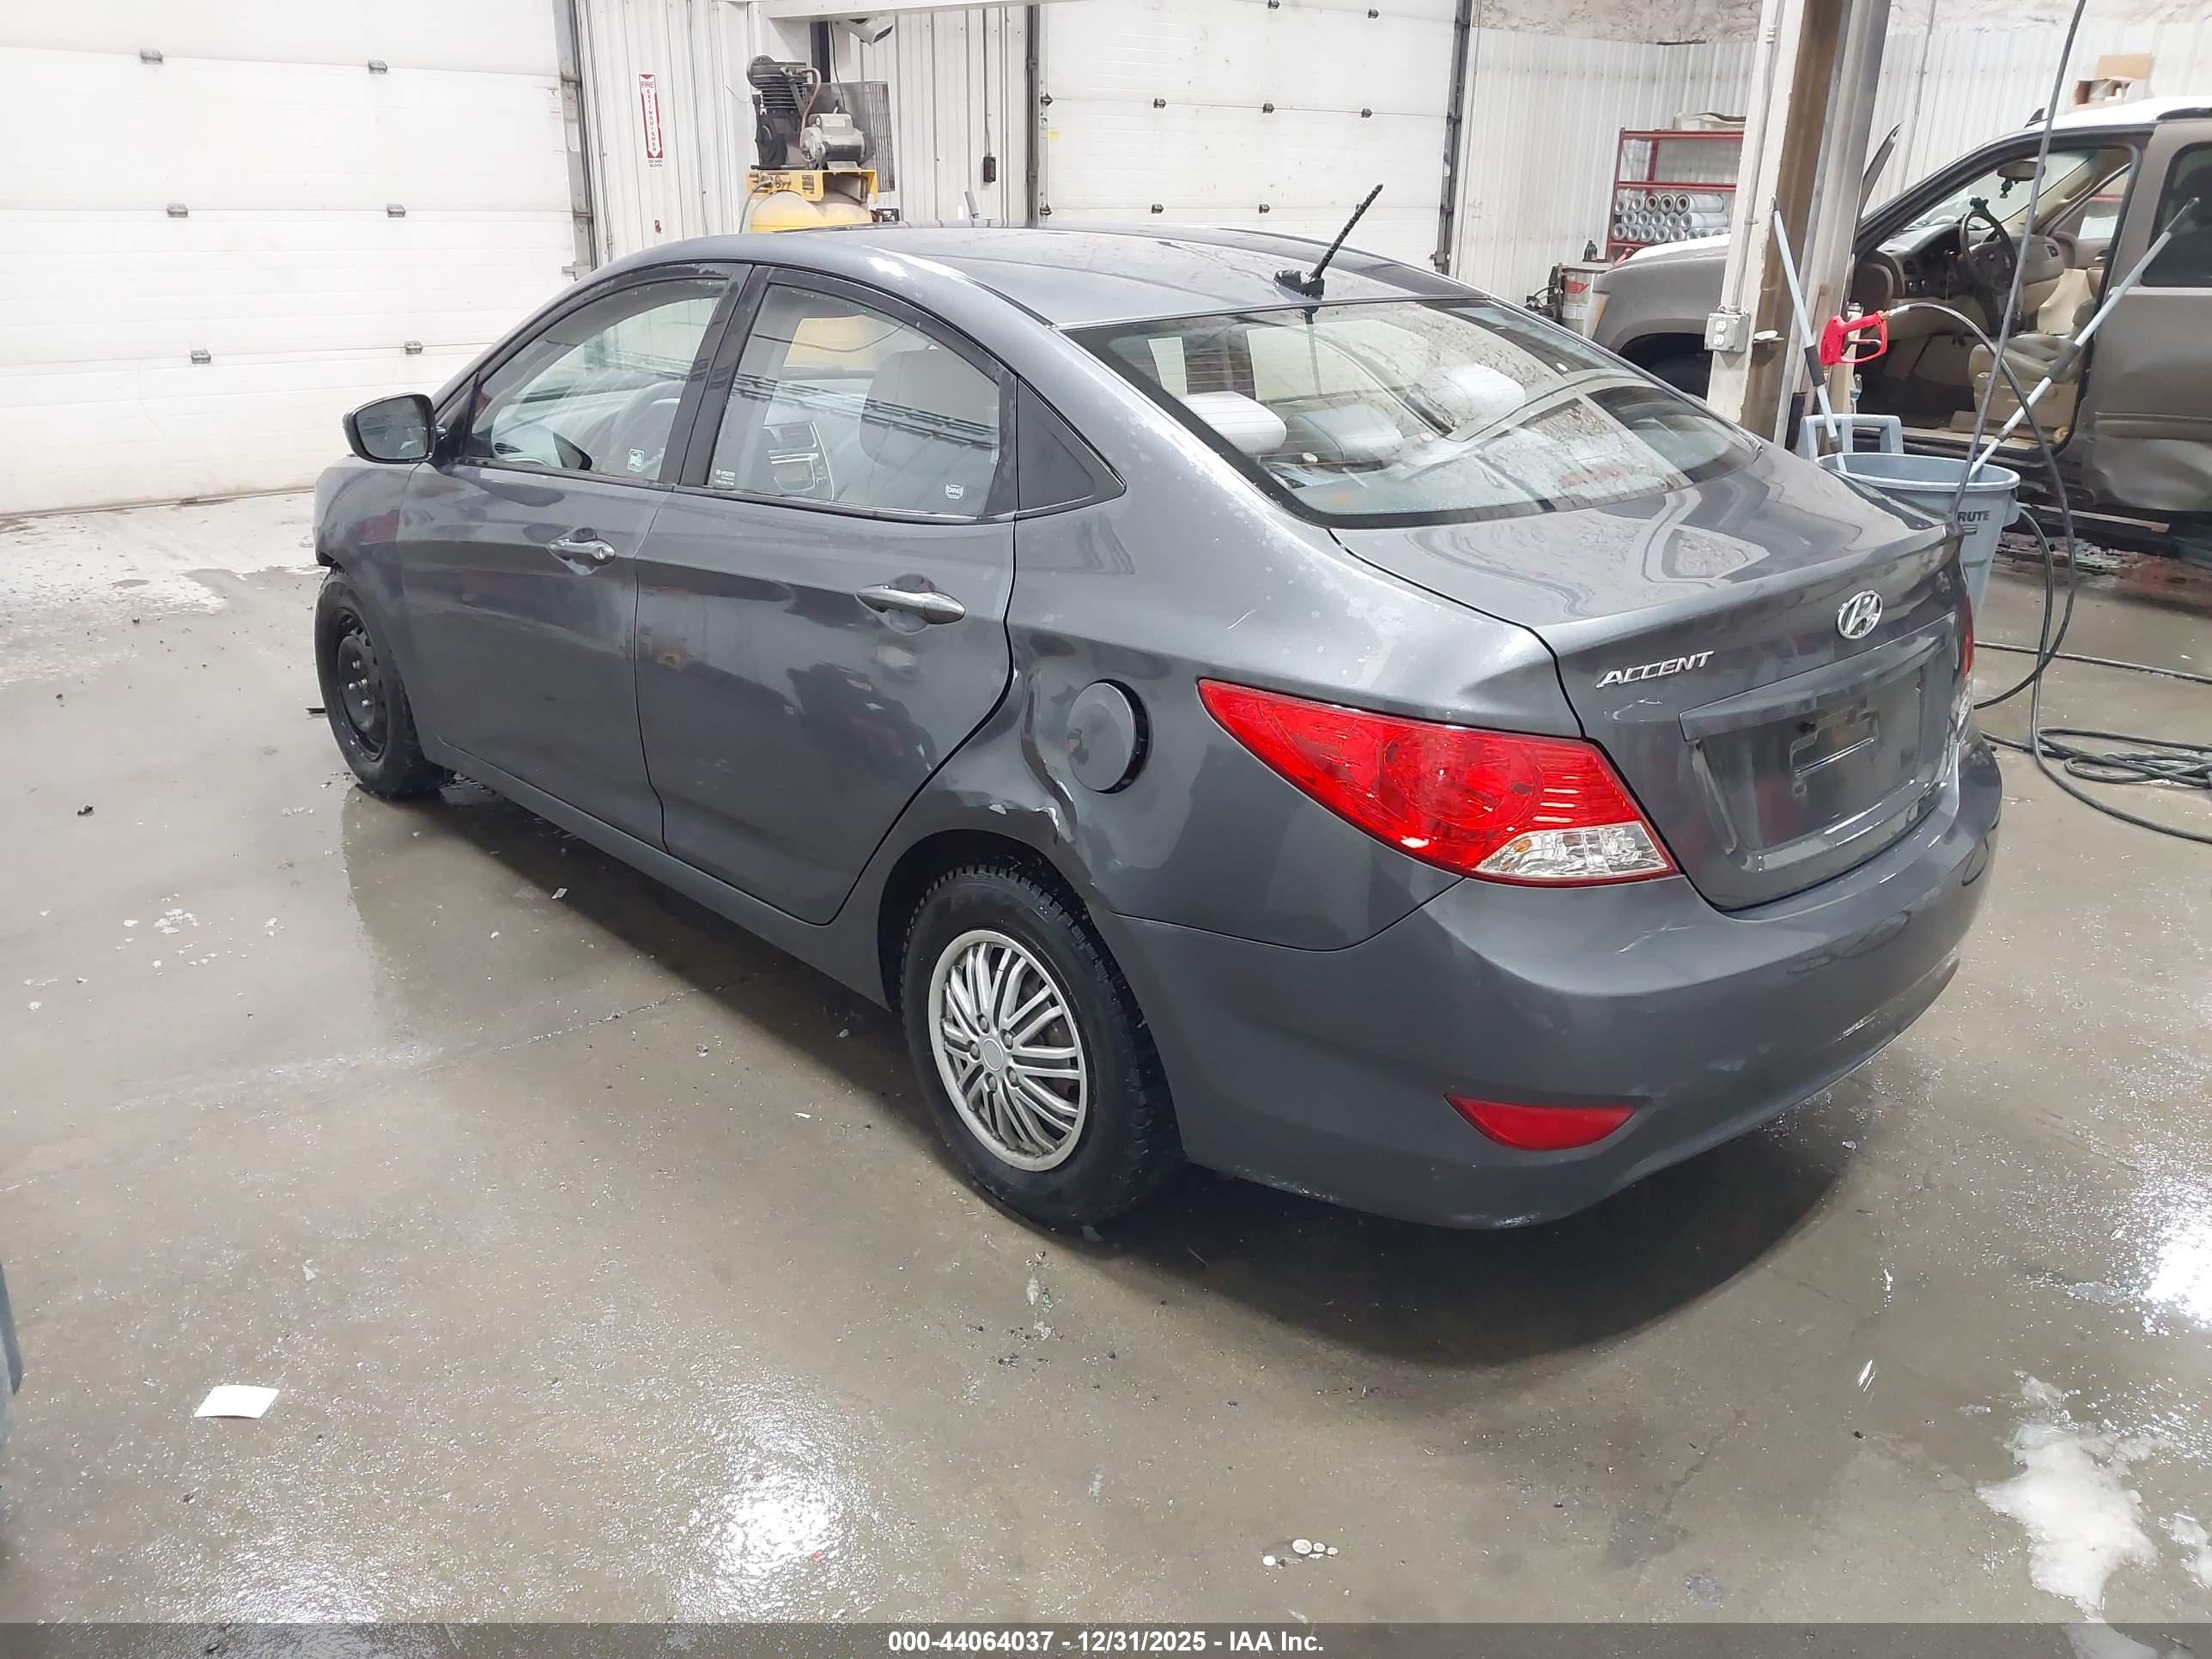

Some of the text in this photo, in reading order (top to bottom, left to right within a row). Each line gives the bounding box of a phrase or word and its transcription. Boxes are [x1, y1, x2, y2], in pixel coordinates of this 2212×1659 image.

[647, 88, 657, 151] EXTINGUISHER
[1957, 510, 1991, 523] RUTE
[1595, 650, 1715, 689] ACCENT
